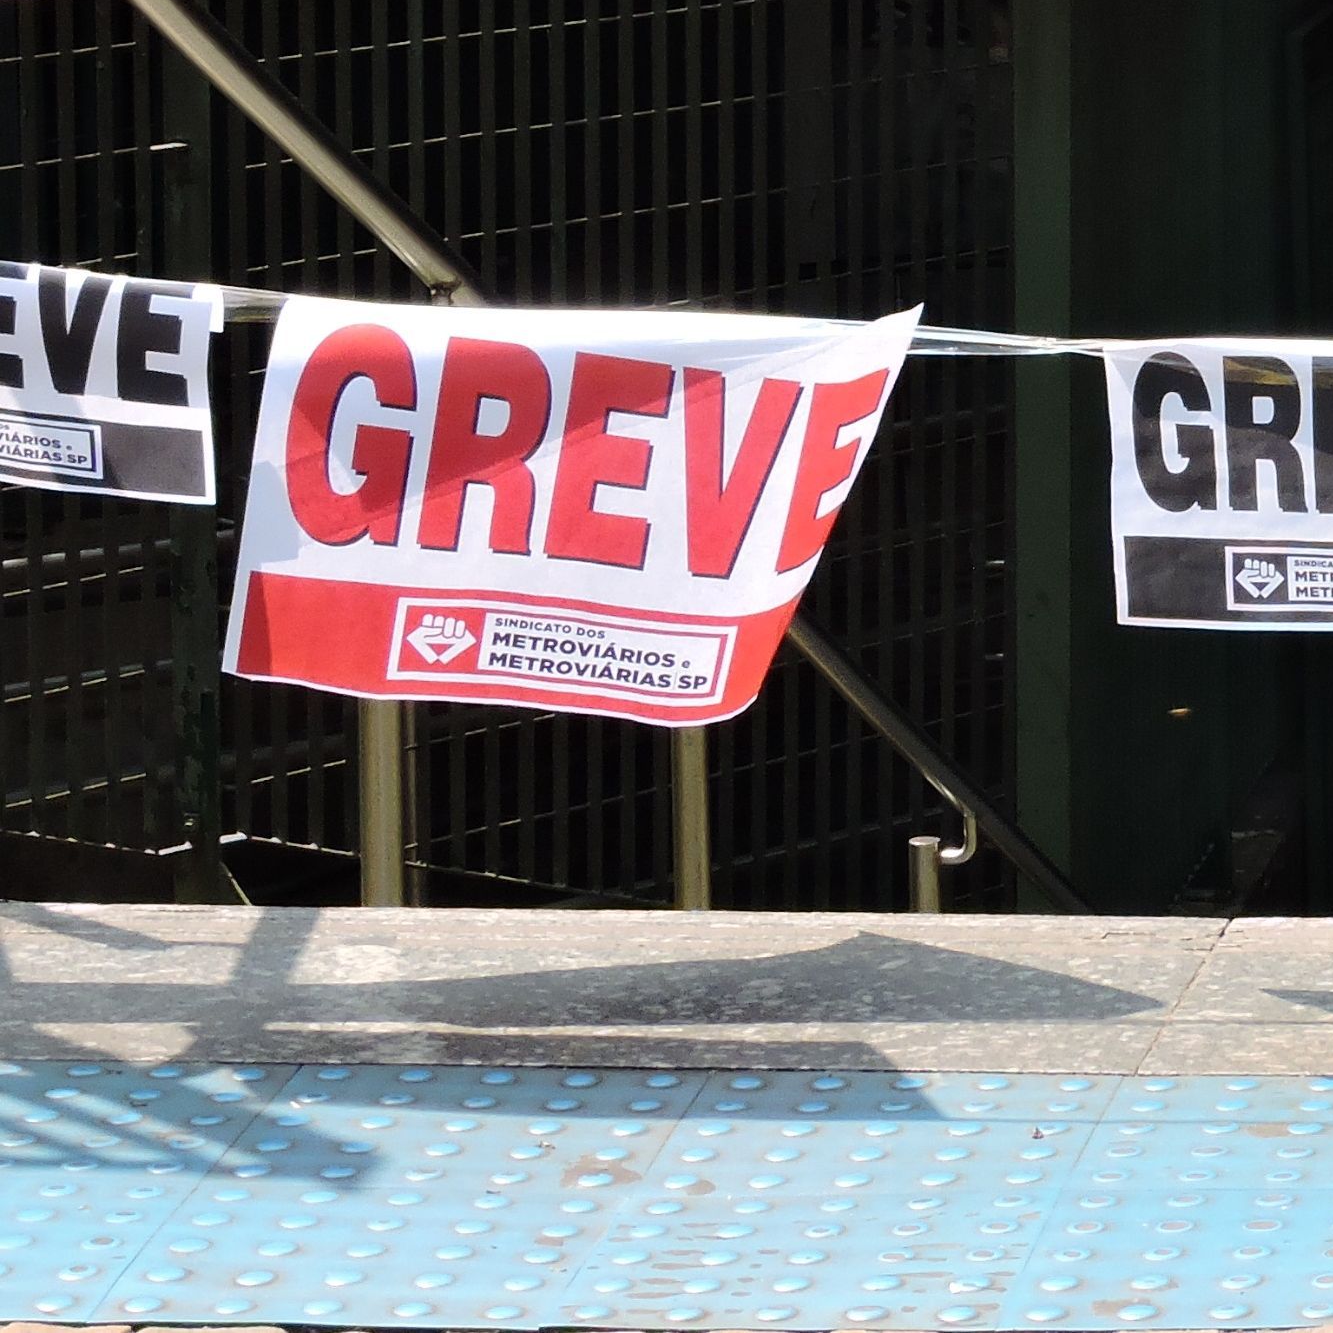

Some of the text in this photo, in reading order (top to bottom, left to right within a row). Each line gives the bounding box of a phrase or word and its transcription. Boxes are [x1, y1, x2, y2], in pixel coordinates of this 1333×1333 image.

[285, 323, 890, 580] GREVE
[495, 617, 605, 639] SINDICATO DOS
[492, 632, 675, 667] METROVIÁRIOS
[488, 652, 708, 690] METROVIÁRIAS SP
